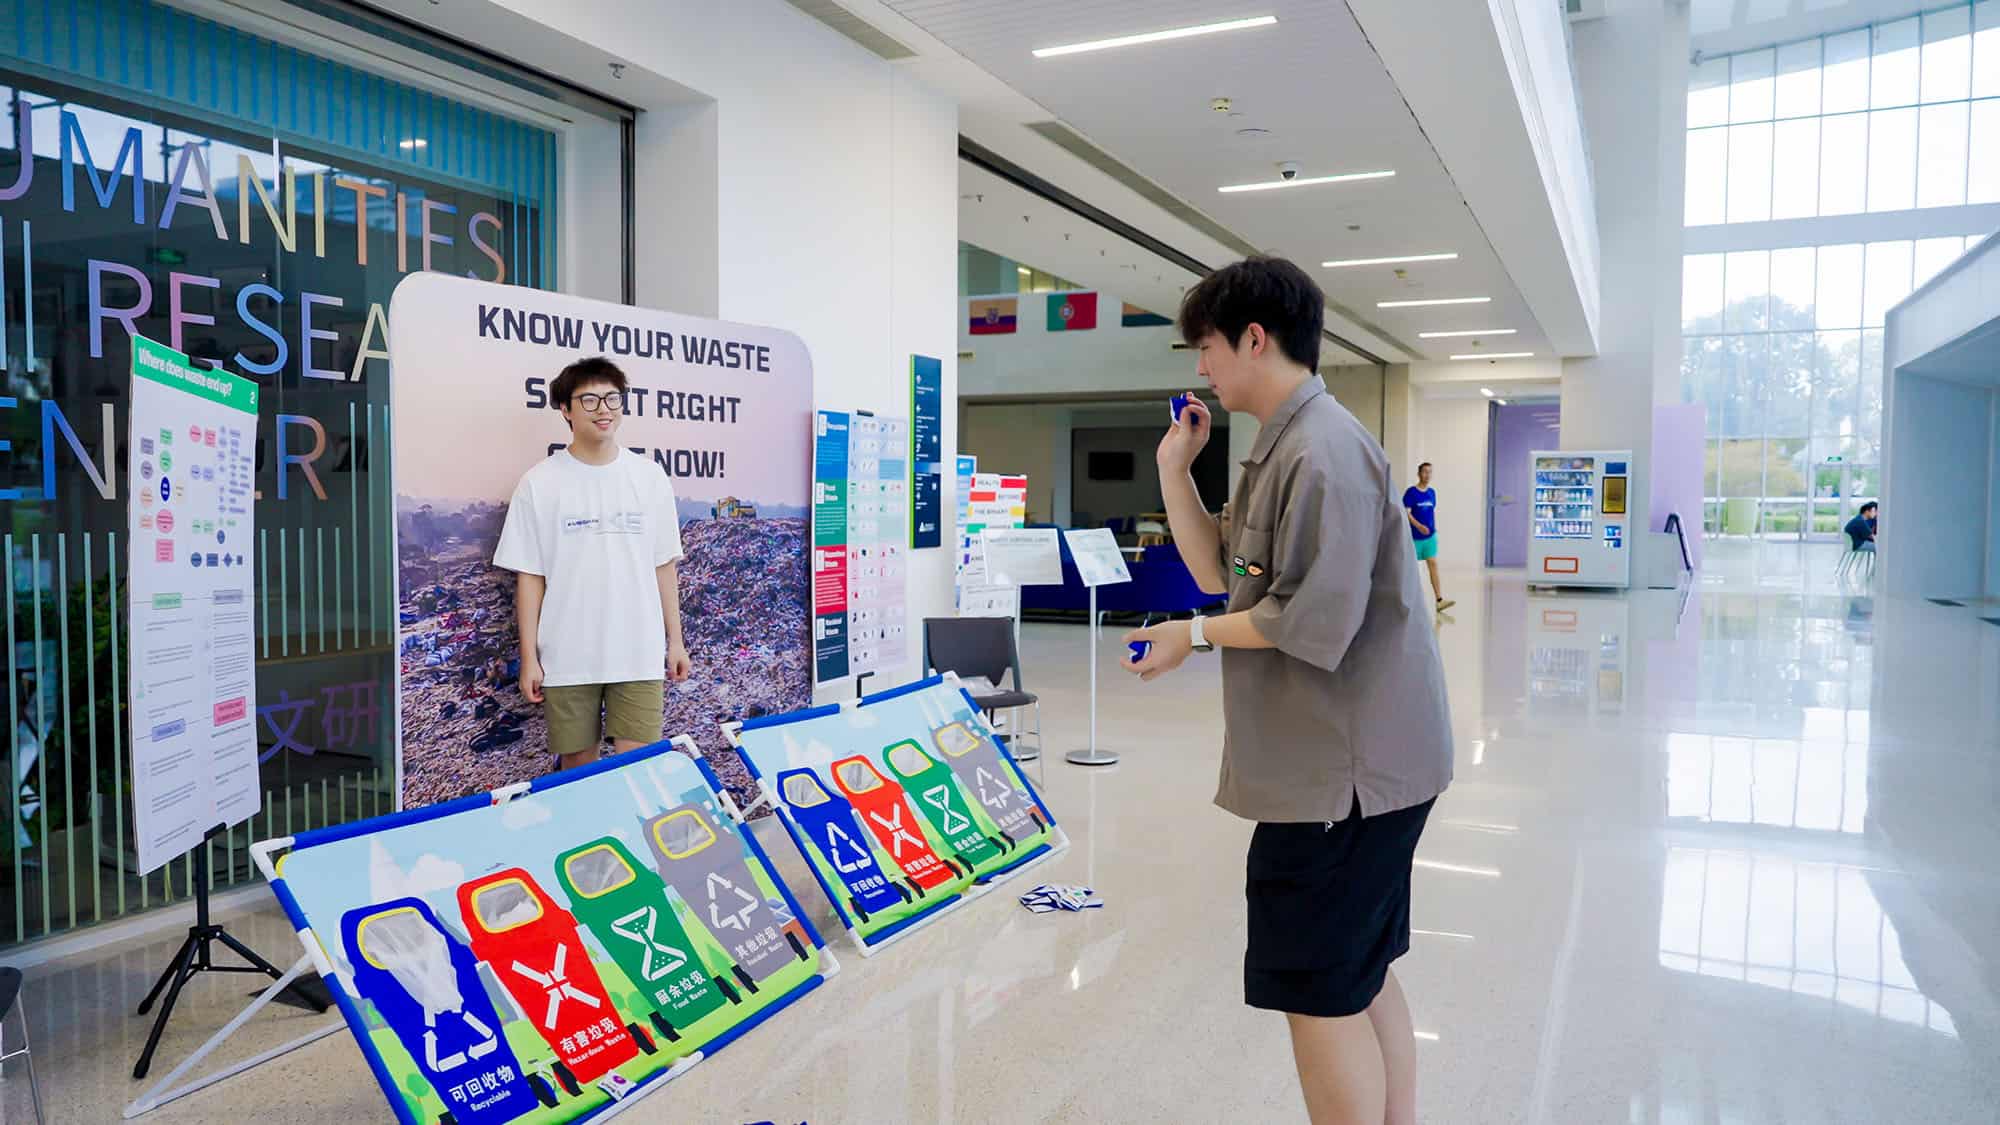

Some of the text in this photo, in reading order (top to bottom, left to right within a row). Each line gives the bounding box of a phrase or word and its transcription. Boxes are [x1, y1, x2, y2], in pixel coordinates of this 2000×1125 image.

[478, 304, 770, 373] KNOW YOUR WASTE
[138, 347, 165, 372] Where
[166, 360, 183, 379] does
[249, 392, 257, 405] 2
[622, 387, 740, 423] IT RIGHT
[654, 448, 725, 479] NOW!
[560, 1017, 618, 1054] 有害垃圾
[448, 1065, 515, 1103] 可回收物
[470, 1090, 512, 1112] Recyclable
